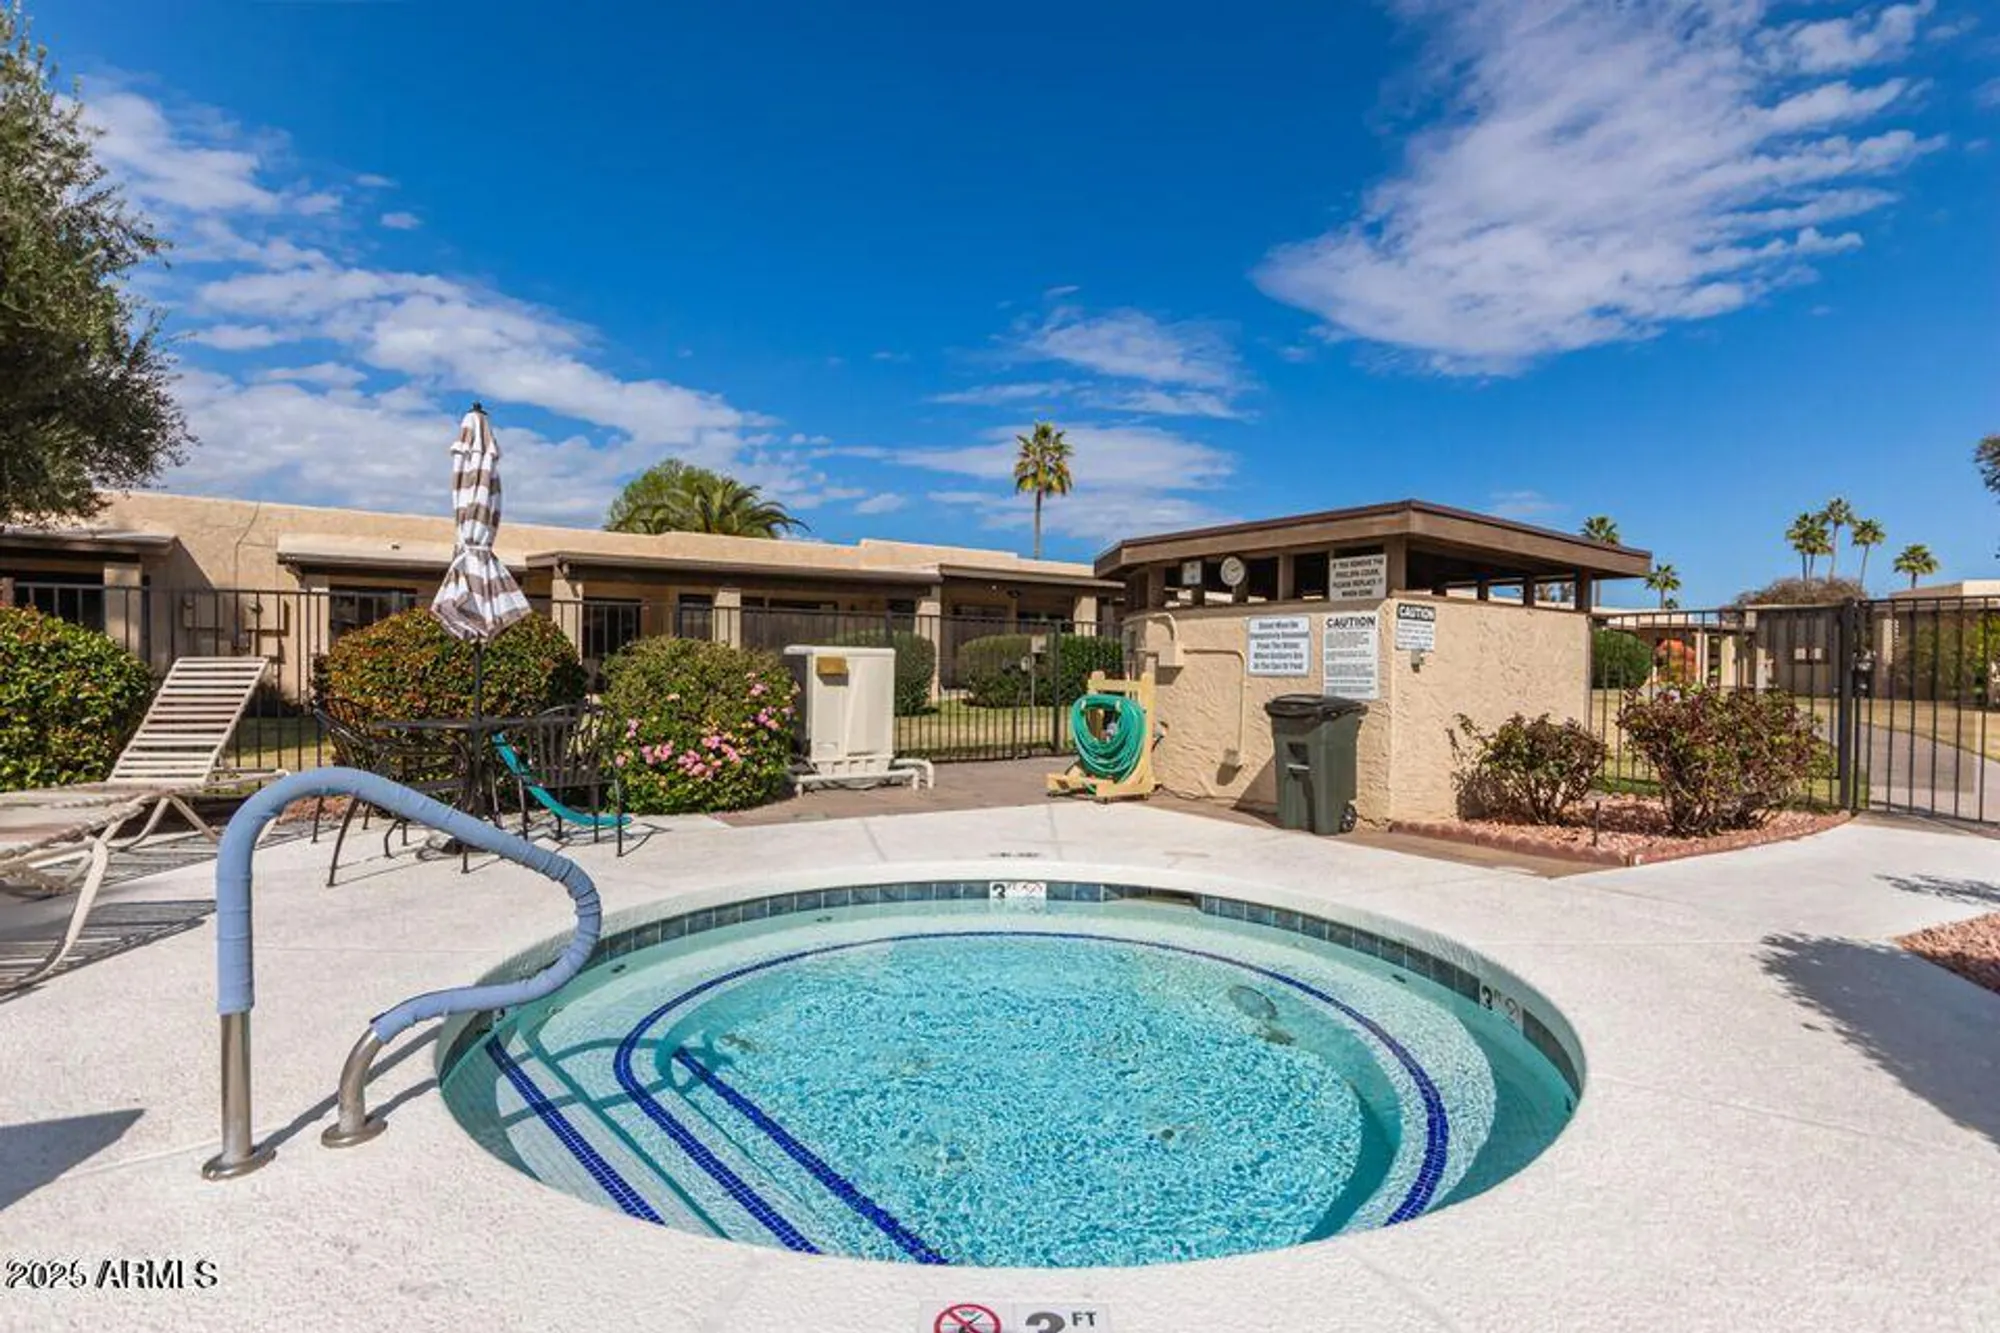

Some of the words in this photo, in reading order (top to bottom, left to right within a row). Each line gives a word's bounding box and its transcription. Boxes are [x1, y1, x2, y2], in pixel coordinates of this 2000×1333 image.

[1350, 559, 1372, 568] REMOVE
[1399, 605, 1434, 620] CAUTION
[1326, 616, 1376, 629] CAUTION
[1071, 1311, 1097, 1327] FT
